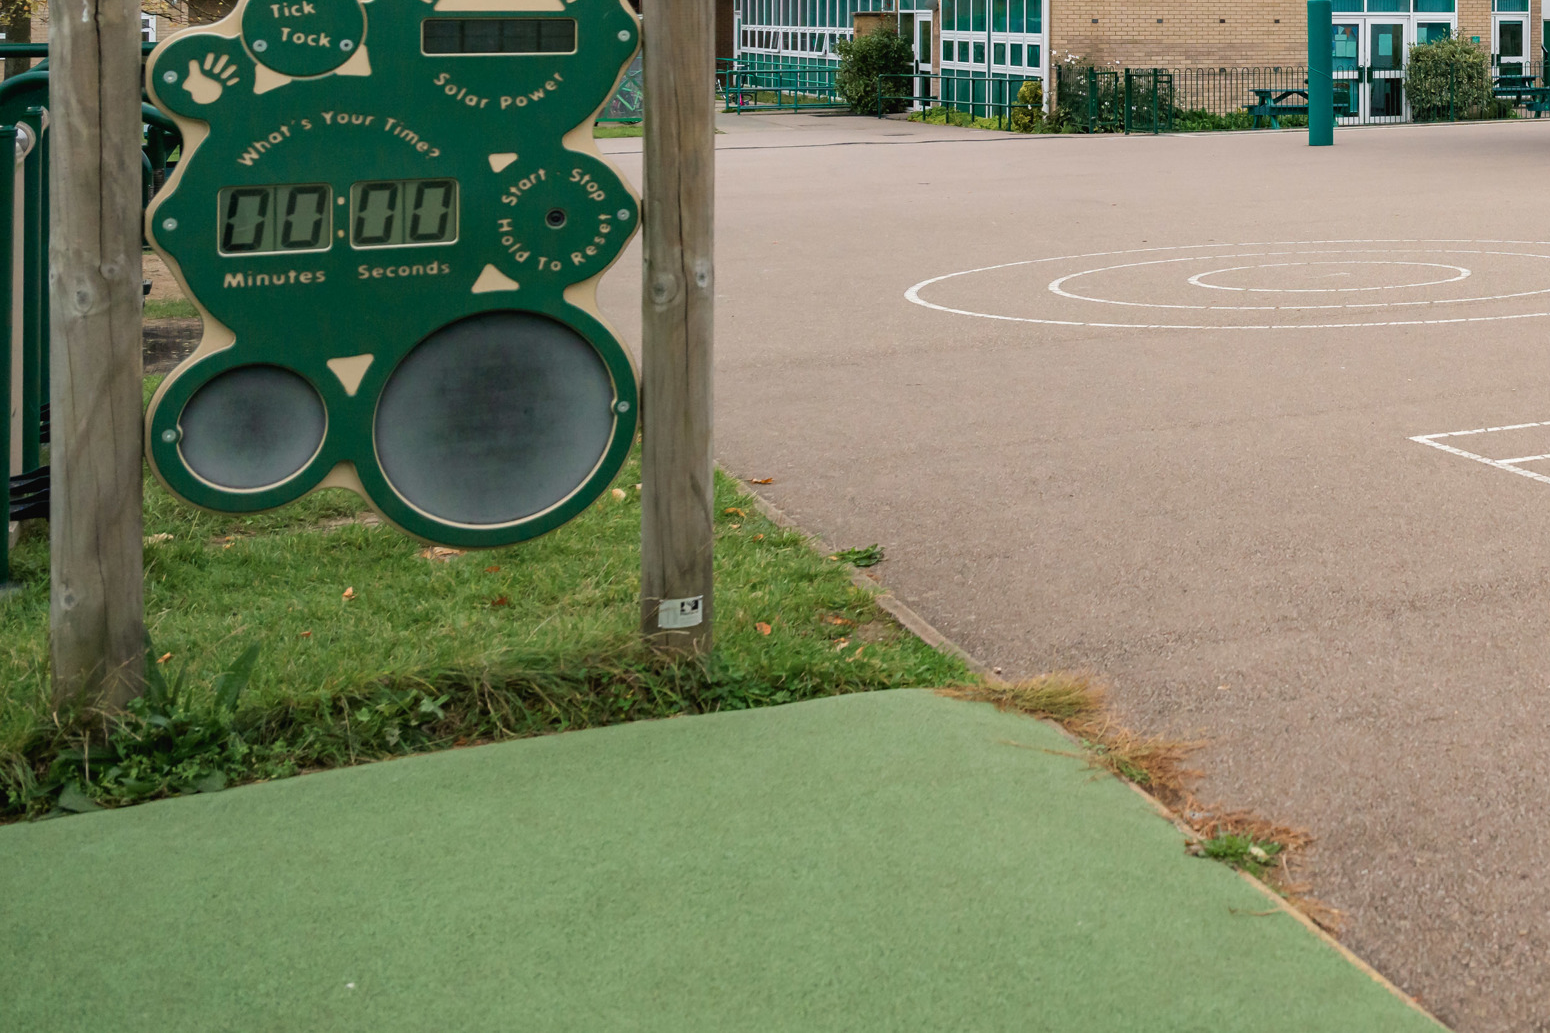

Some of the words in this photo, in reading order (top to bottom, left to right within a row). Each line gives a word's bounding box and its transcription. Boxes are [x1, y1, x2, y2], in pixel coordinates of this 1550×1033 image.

[270, 0, 316, 18] Tick
[281, 27, 331, 47] Tock
[433, 72, 489, 108] Solar
[500, 72, 563, 109] Power
[237, 118, 312, 166] What's
[321, 111, 374, 125] Your
[384, 117, 440, 158] Time?
[501, 168, 546, 206] Start
[569, 168, 606, 201] Stop
[497, 218, 531, 263] Hold
[538, 256, 562, 271] To
[570, 213, 612, 266] Reset
[223, 269, 326, 288] Minutes
[358, 261, 451, 279] Seconds
